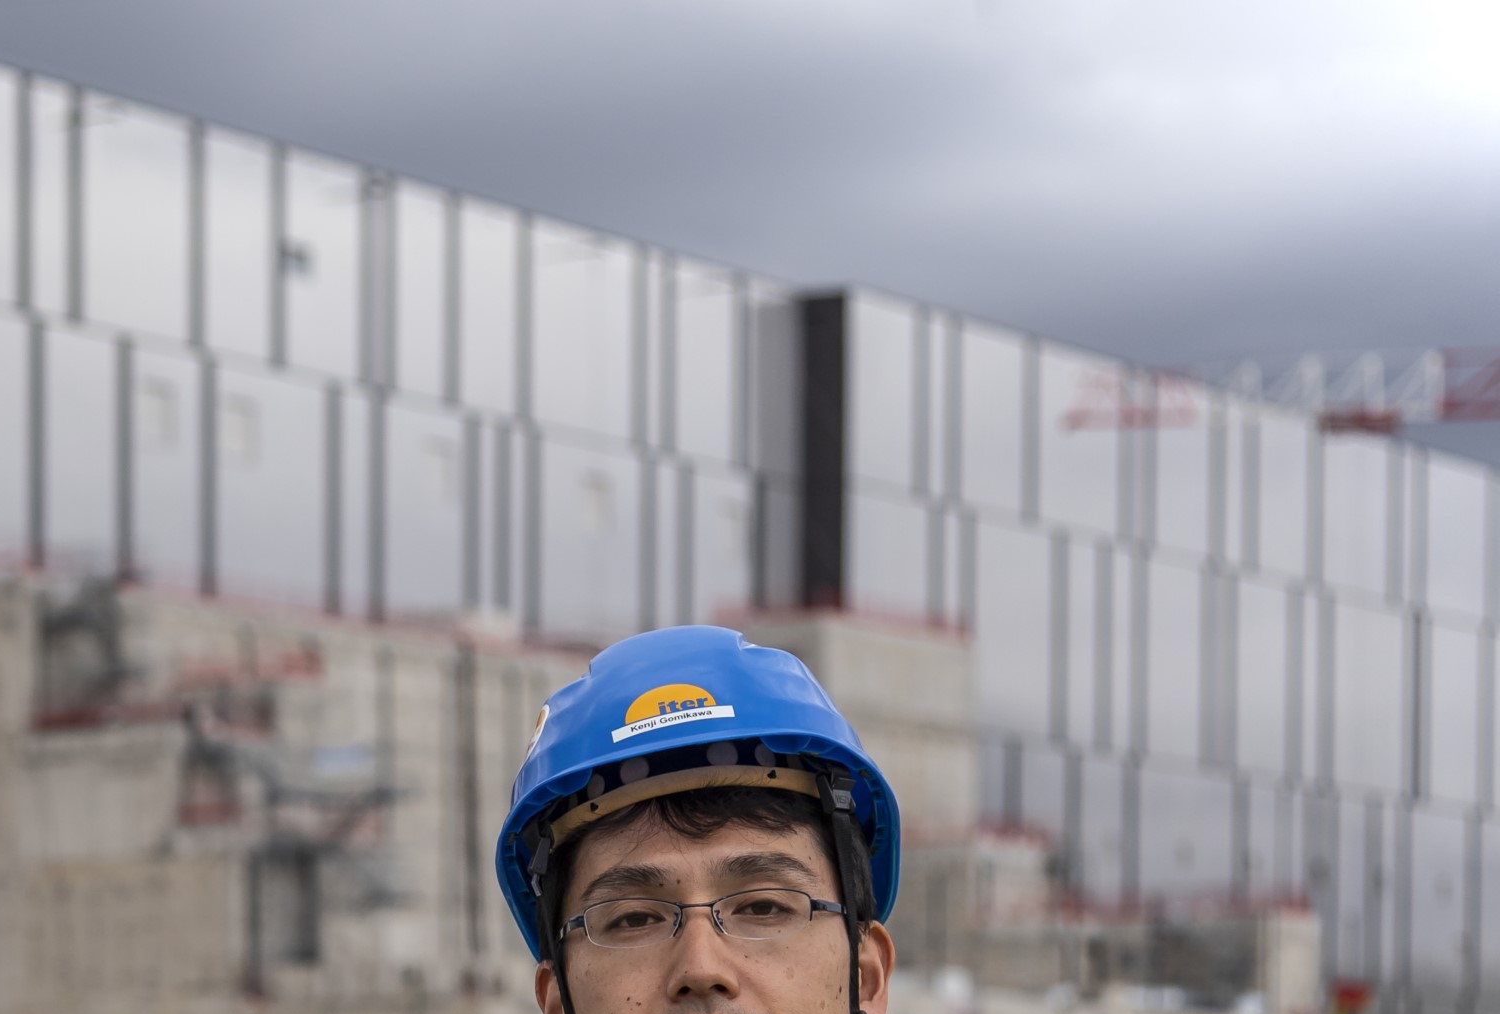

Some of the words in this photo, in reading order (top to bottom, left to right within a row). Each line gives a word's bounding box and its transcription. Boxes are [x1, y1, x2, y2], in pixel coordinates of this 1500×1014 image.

[658, 697, 709, 715] iter
[630, 720, 657, 733] Kenji
[660, 709, 712, 724] Gomikawa
